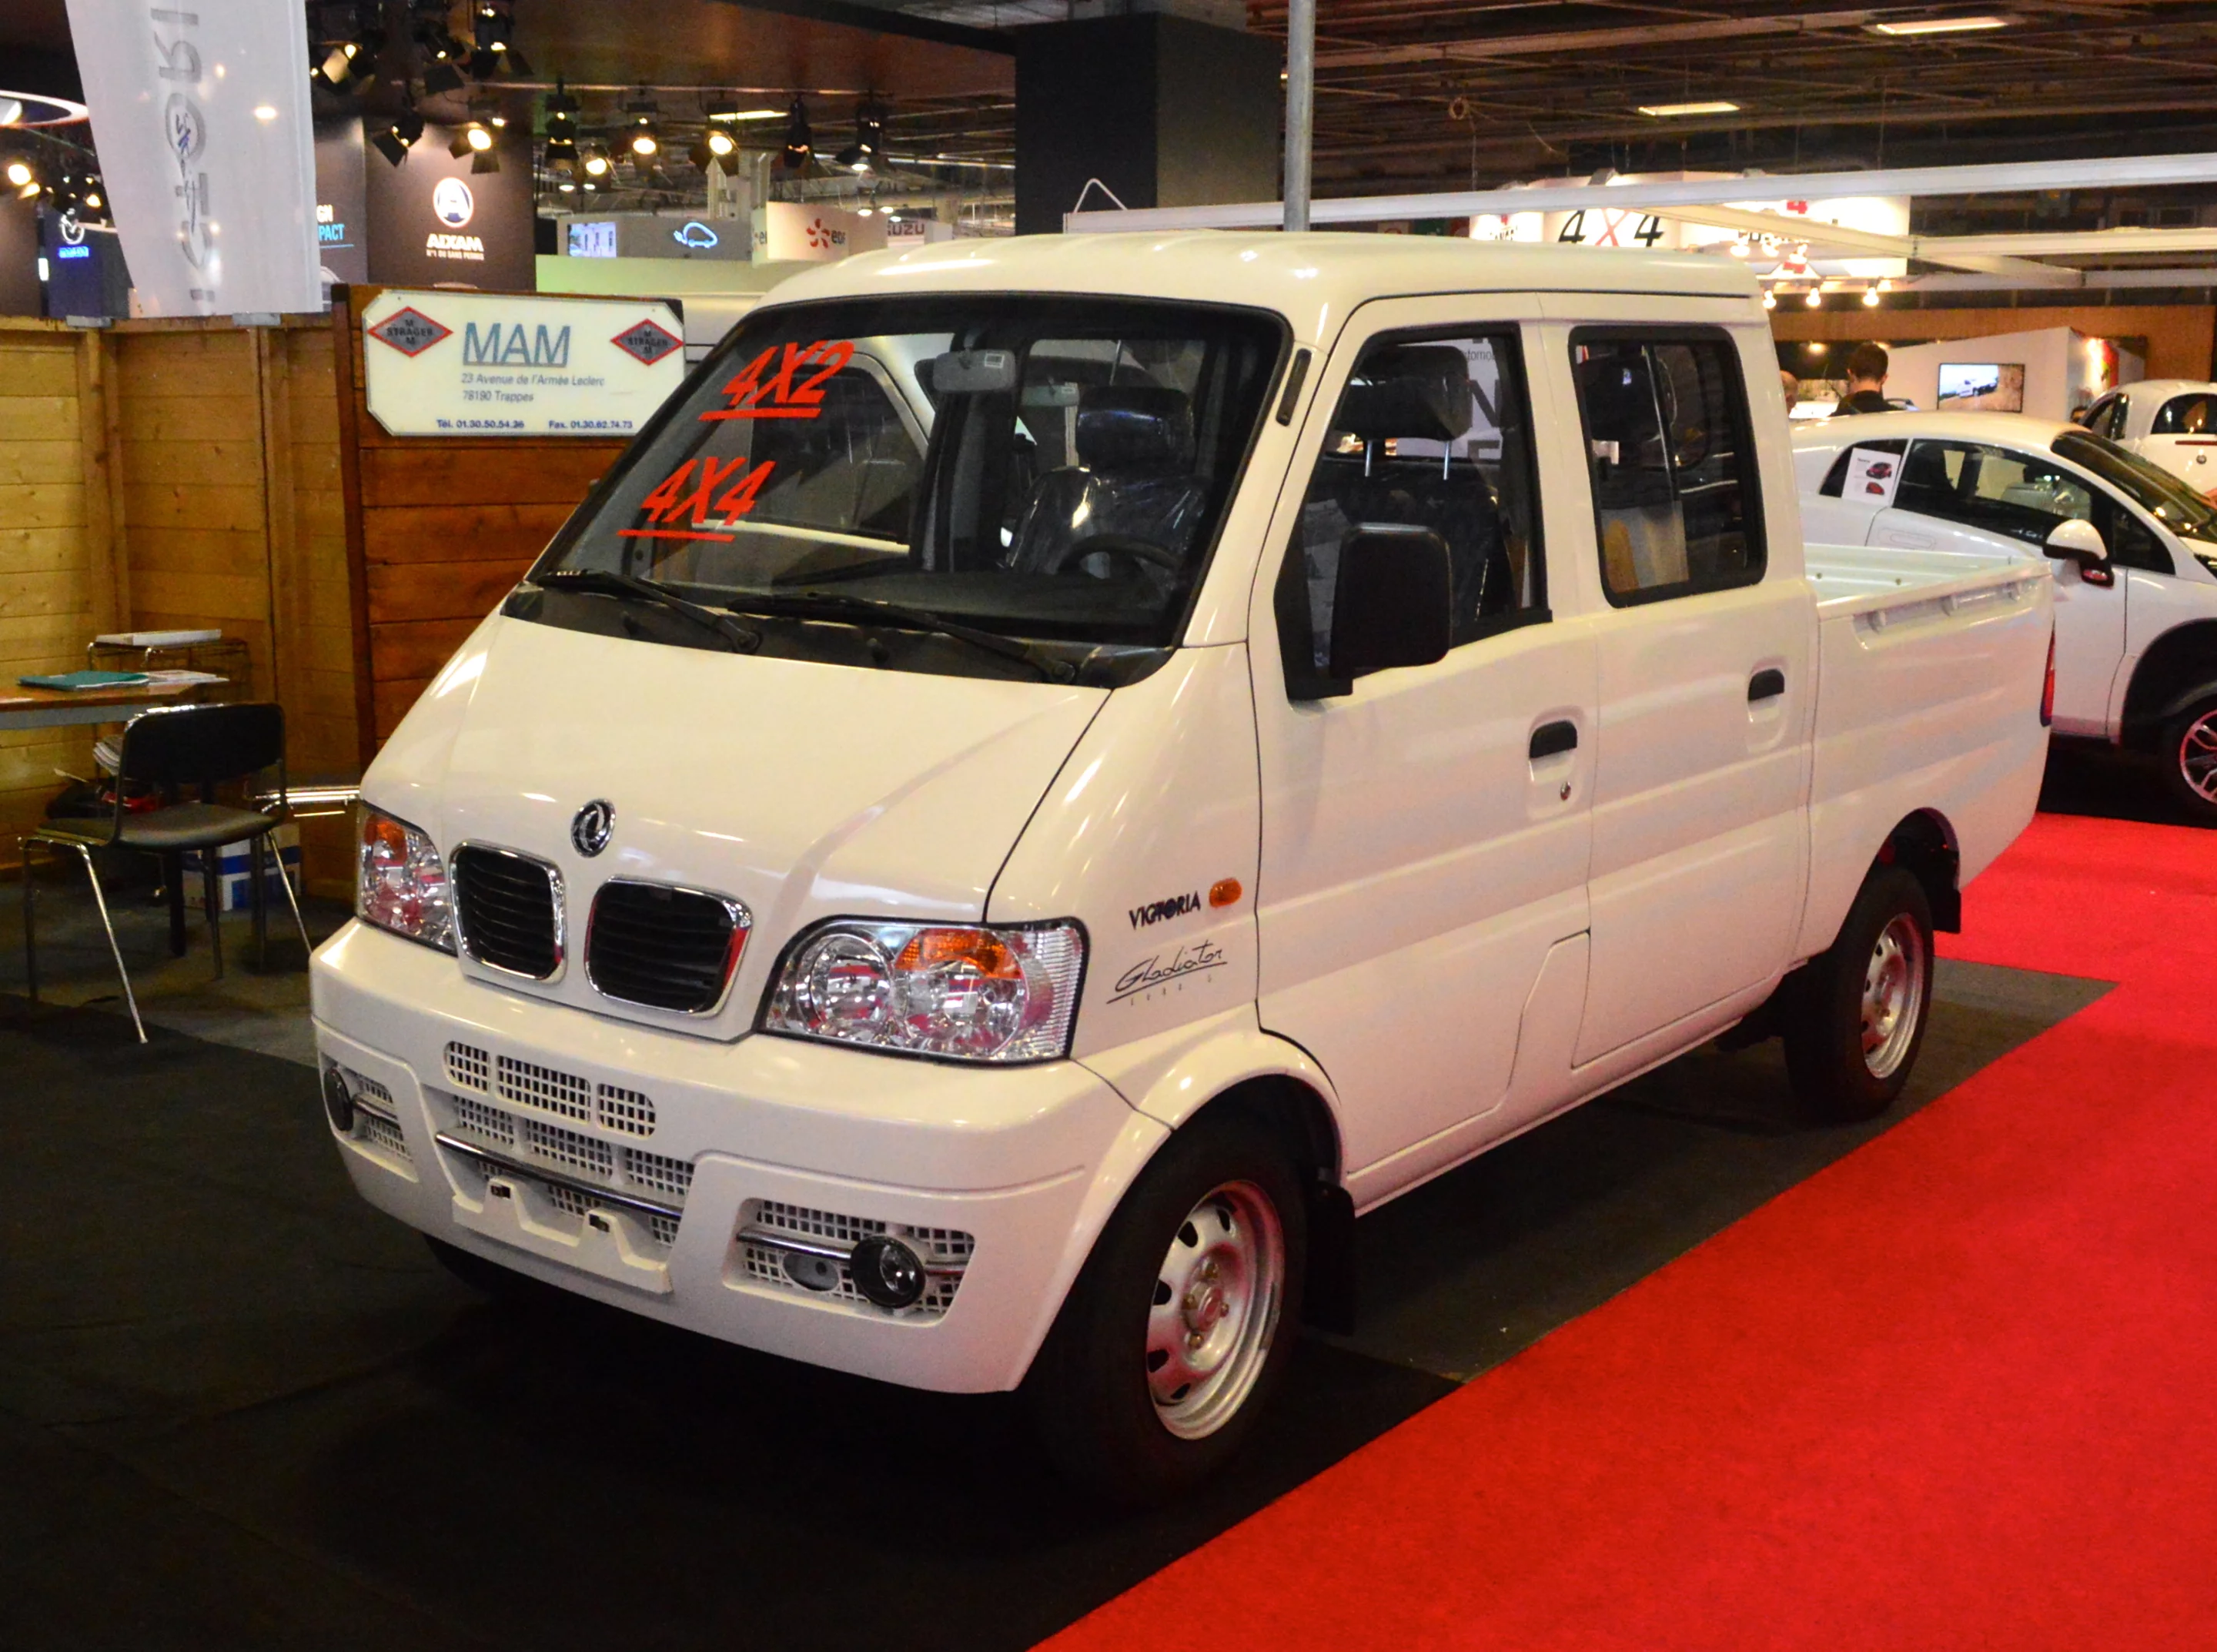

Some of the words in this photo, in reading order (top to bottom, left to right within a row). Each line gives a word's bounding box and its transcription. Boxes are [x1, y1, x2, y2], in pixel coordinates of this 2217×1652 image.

[426, 233, 484, 252] AIXAM
[463, 322, 570, 367] MAM
[461, 373, 474, 384] 23
[476, 374, 513, 386] Avenue
[517, 374, 529, 386] de
[572, 376, 605, 387] Leclerc
[721, 339, 855, 406] 4X2
[495, 390, 534, 403] Trappes
[640, 456, 776, 527] 4X4
[1128, 890, 1202, 930] VICTORIA
[1114, 938, 1223, 992] Gladiator
